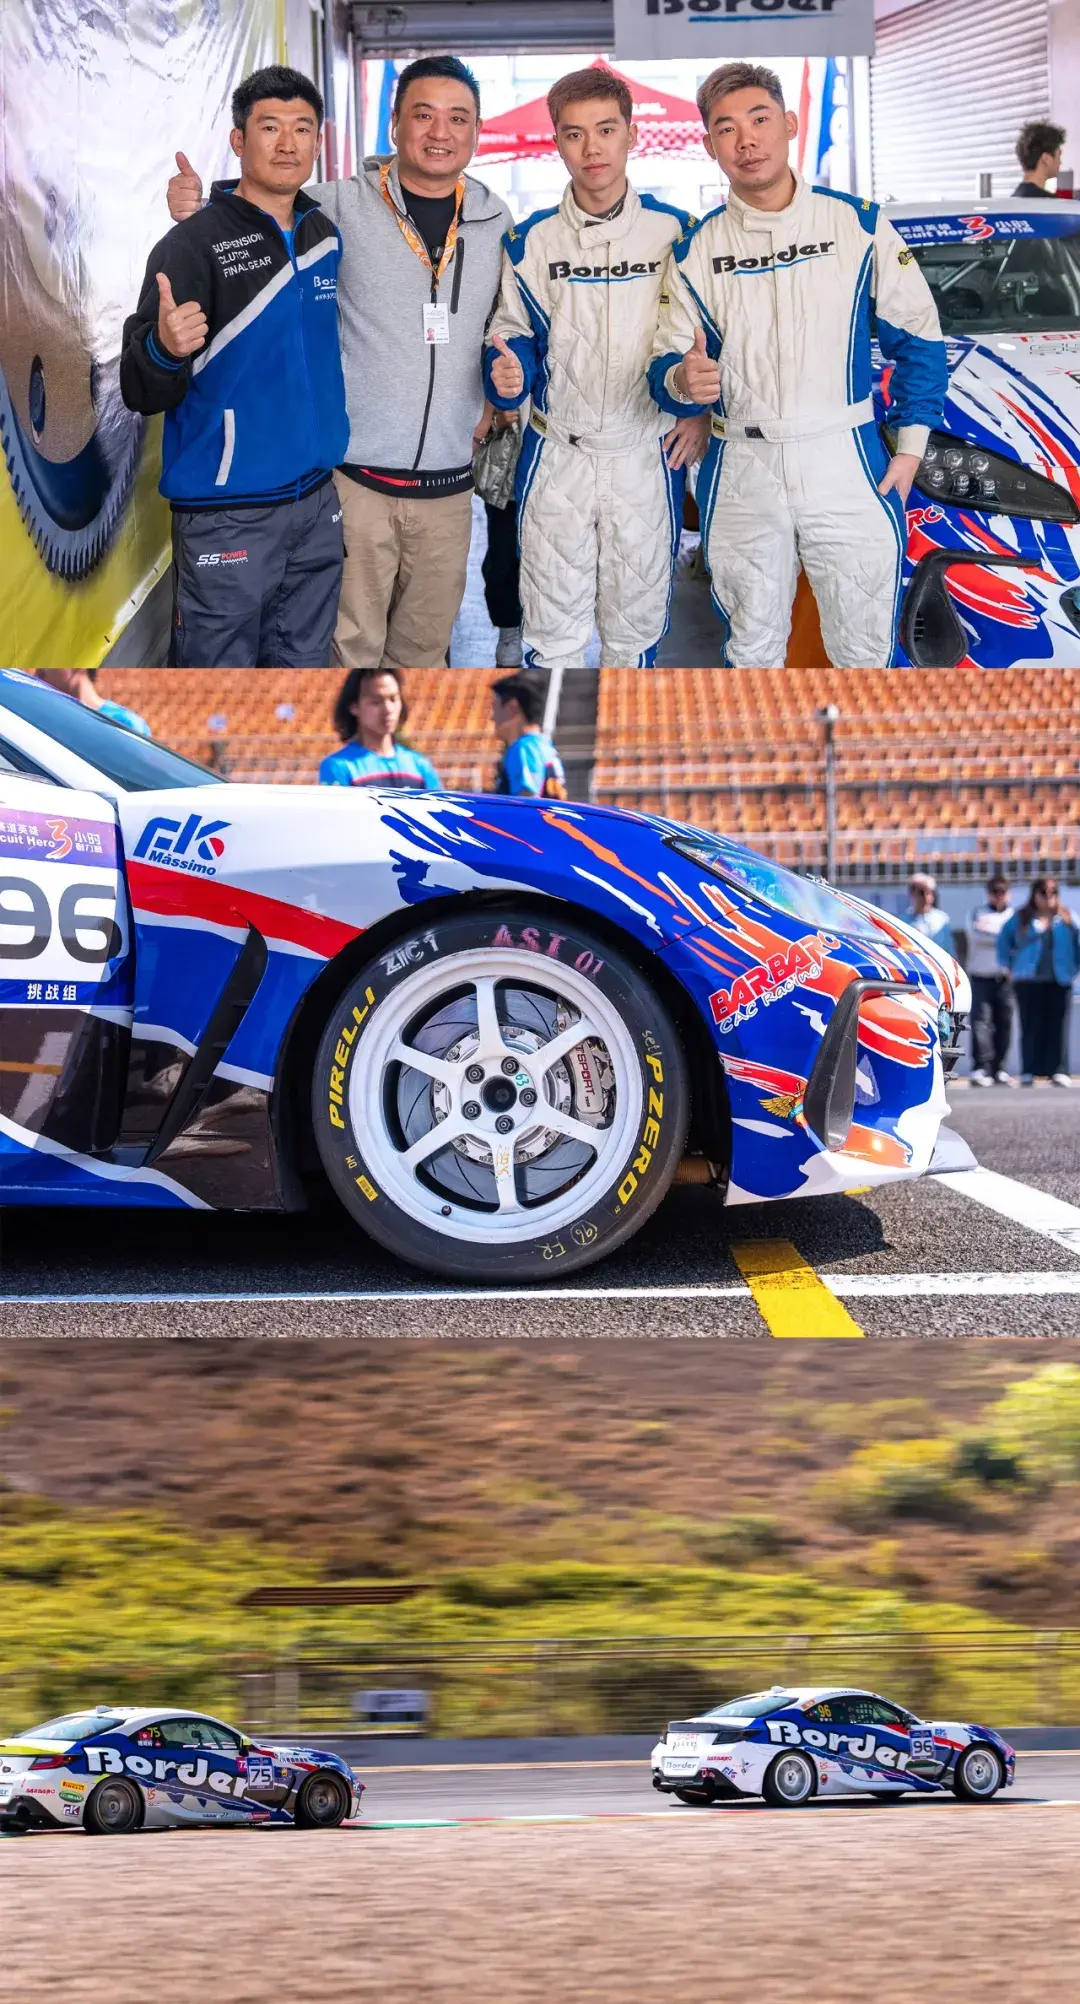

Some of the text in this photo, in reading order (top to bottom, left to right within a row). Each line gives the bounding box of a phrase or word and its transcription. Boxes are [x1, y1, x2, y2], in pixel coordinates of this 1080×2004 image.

[936, 227, 974, 237] Hero
[958, 215, 994, 242] 3
[212, 232, 264, 254] SUSPENSION
[218, 250, 250, 265] CLUTCH
[223, 255, 272, 278] FINAL GEAR
[712, 240, 835, 275] Border
[549, 260, 661, 281] Border
[196, 553, 221, 566] SS
[221, 549, 247, 560] POWER
[26, 835, 56, 848] Hero
[45, 819, 73, 860] 3
[74, 831, 101, 846] 小时
[0, 876, 123, 964] 96
[708, 930, 841, 1024] BARBARO
[761, 963, 821, 1007] Racing
[27, 983, 77, 1001] 挑战组
[328, 986, 376, 1129] PIRELLI
[515, 1073, 530, 1087] 63
[817, 1704, 832, 1718] 96
[147, 1727, 160, 1738] 75
[765, 1719, 912, 1771] Border
[913, 1740, 933, 1754] 96
[83, 1746, 248, 1798] Border
[666, 1761, 697, 1769] Border
[250, 1768, 272, 1783] 75
